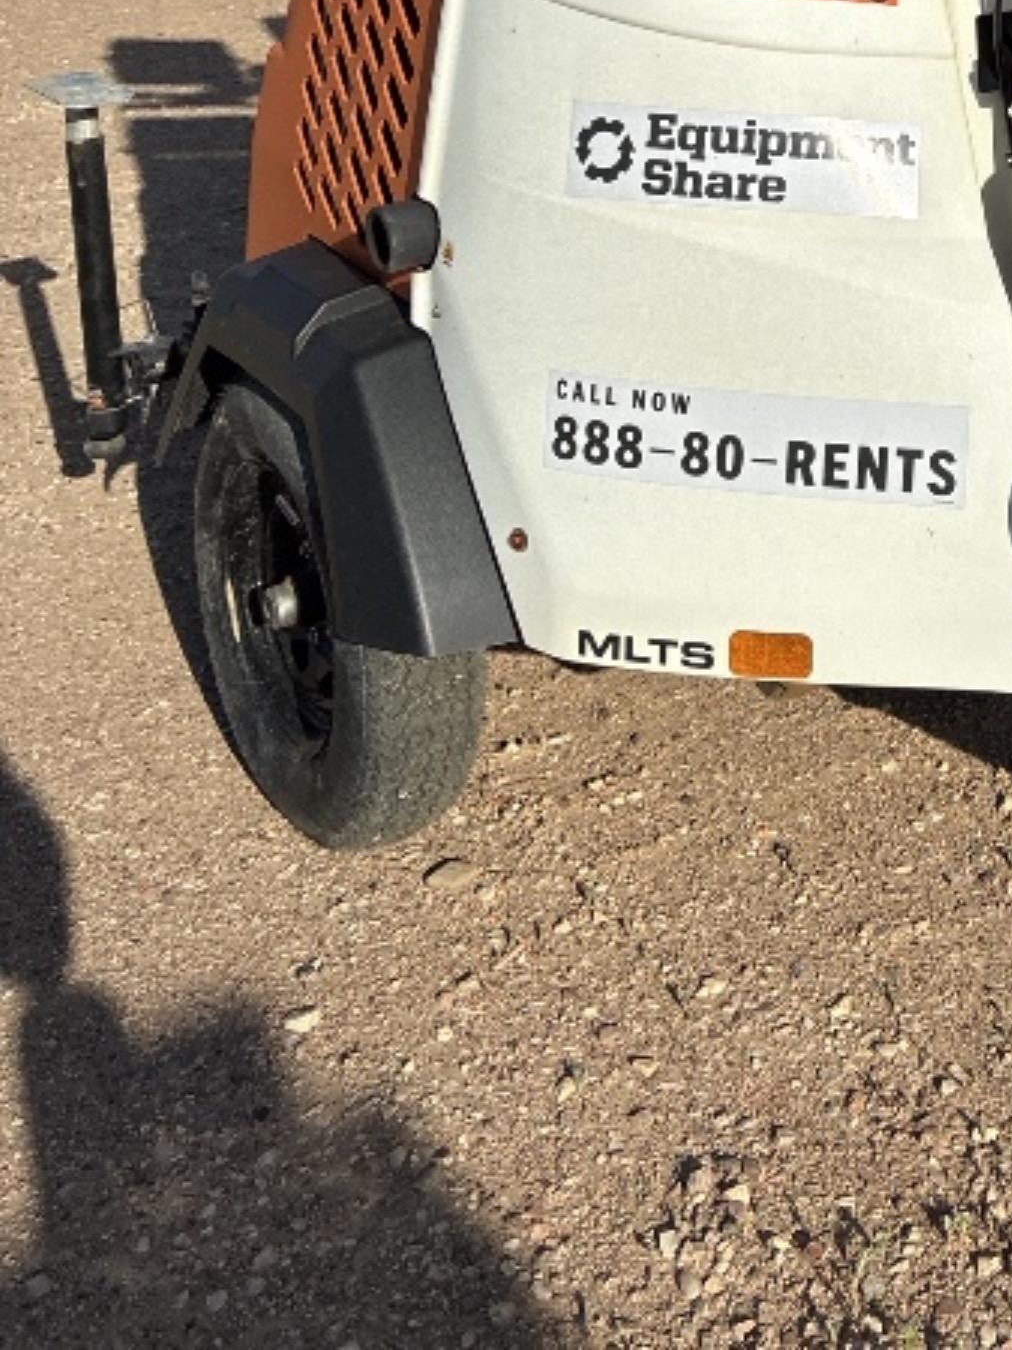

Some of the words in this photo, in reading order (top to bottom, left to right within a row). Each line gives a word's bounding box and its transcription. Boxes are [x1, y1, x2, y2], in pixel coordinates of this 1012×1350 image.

[646, 113, 916, 166] Equipmnt
[641, 158, 787, 203] Share
[557, 378, 617, 406] CALL
[632, 389, 691, 415] NOW
[551, 415, 958, 497] 888-80-RENTS
[578, 629, 715, 669] MLTS
